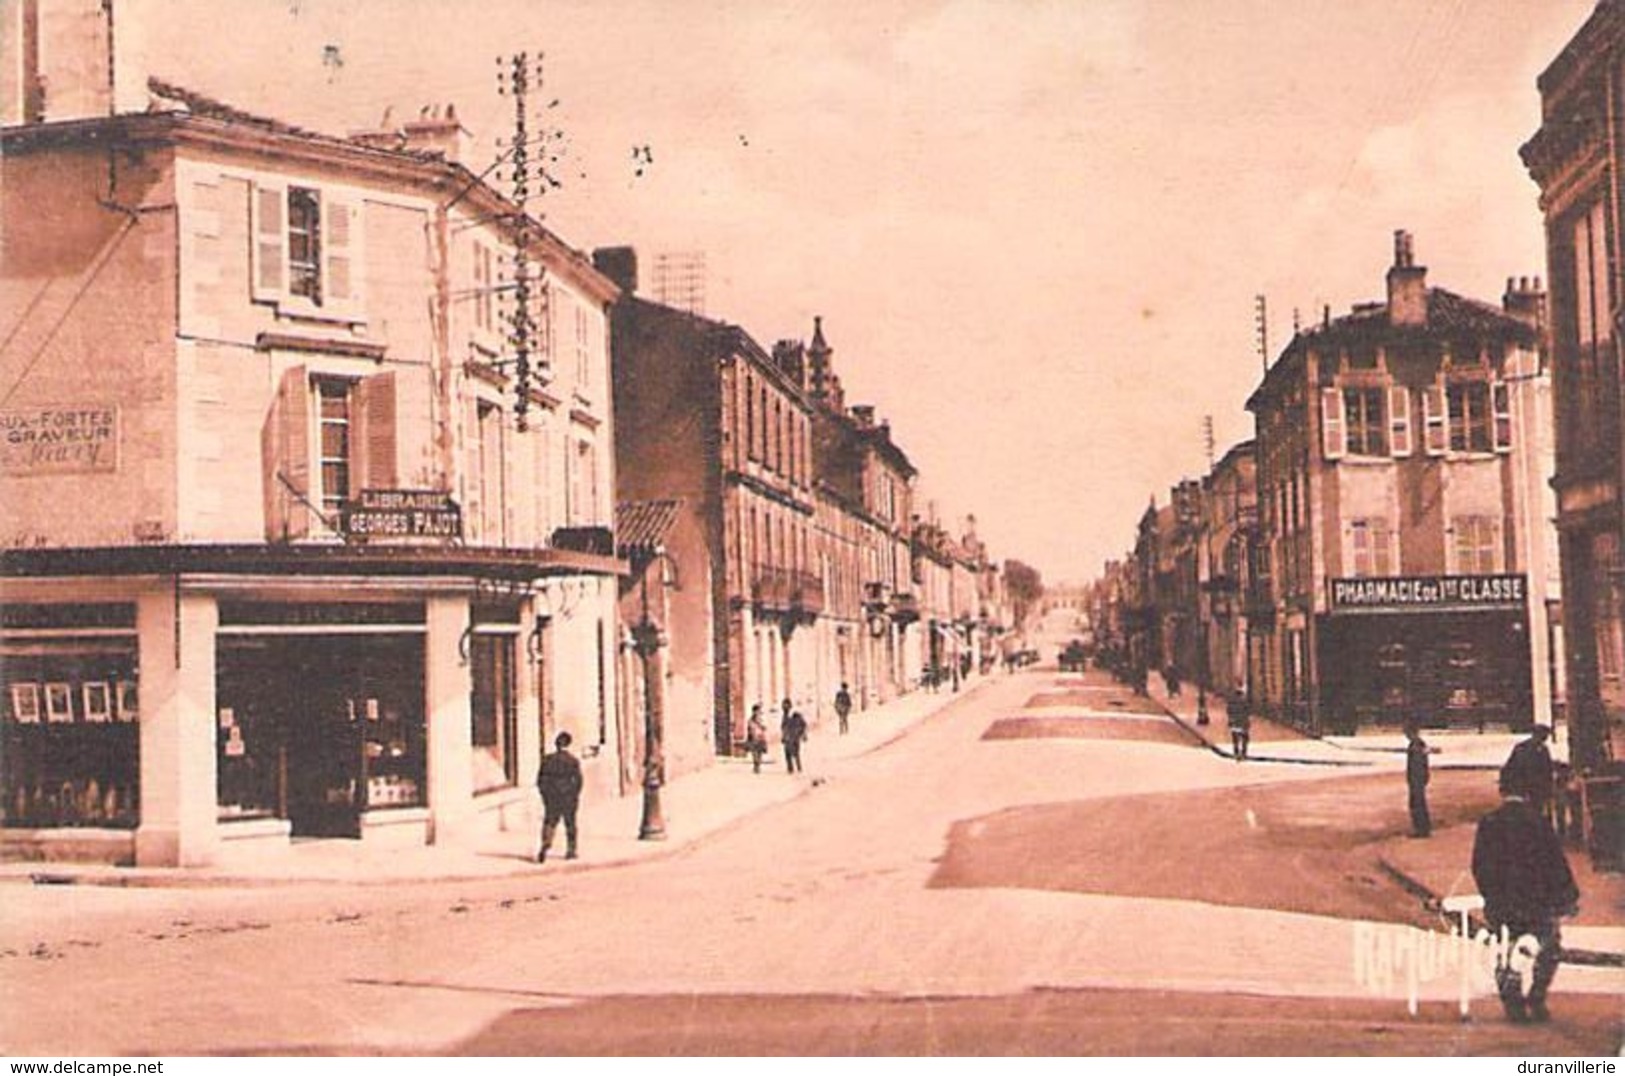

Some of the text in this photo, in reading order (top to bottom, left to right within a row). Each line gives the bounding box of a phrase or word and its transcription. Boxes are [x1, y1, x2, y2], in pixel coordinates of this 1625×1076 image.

[362, 492, 448, 510] LIBRAIRIE
[350, 512, 458, 534] GEORGES PAJOT
[1335, 580, 1421, 603] PHARMACIE
[1460, 577, 1523, 600] CLASSE
